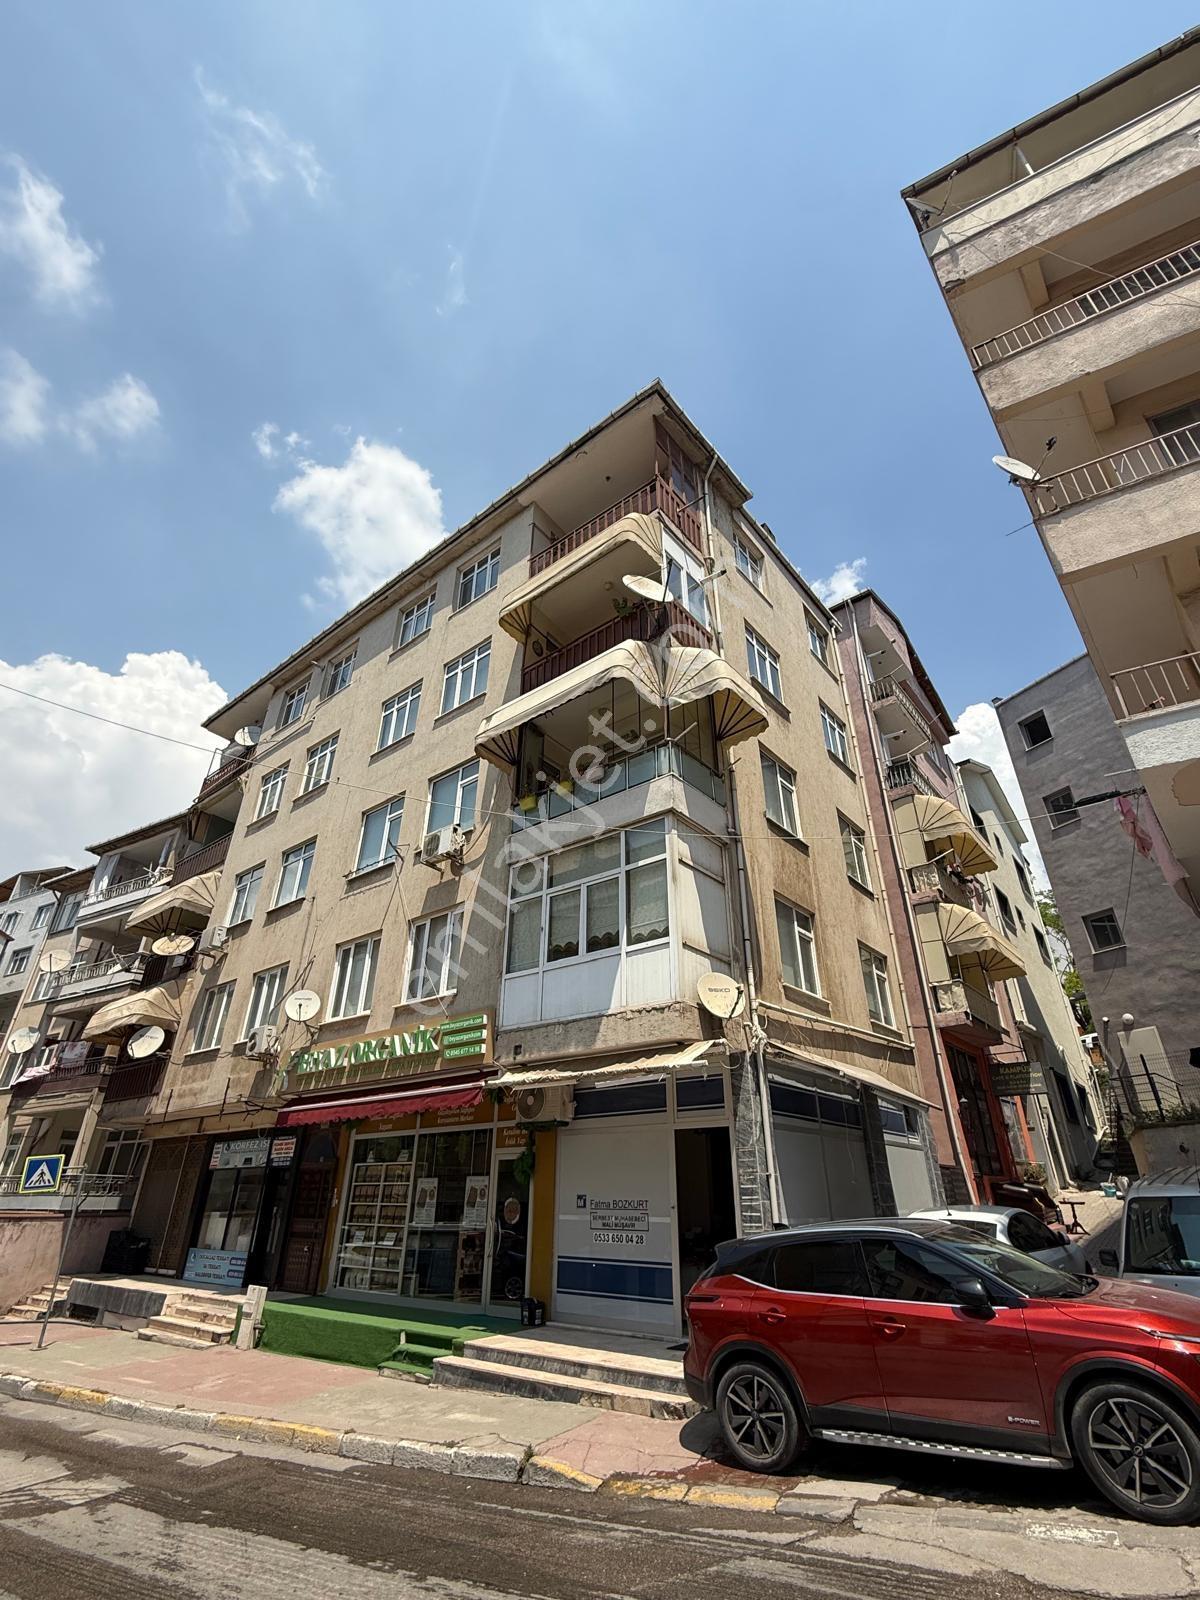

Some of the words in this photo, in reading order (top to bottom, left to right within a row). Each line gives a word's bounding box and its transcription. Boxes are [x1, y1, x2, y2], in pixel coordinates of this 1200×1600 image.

[590, 1199, 611, 1208] Fatma
[612, 1199, 649, 1209] BOZKURT
[593, 1233, 610, 1243] 0533
[611, 1233, 624, 1244] 650
[625, 1234, 634, 1244] 04
[635, 1235, 644, 1245] 28
